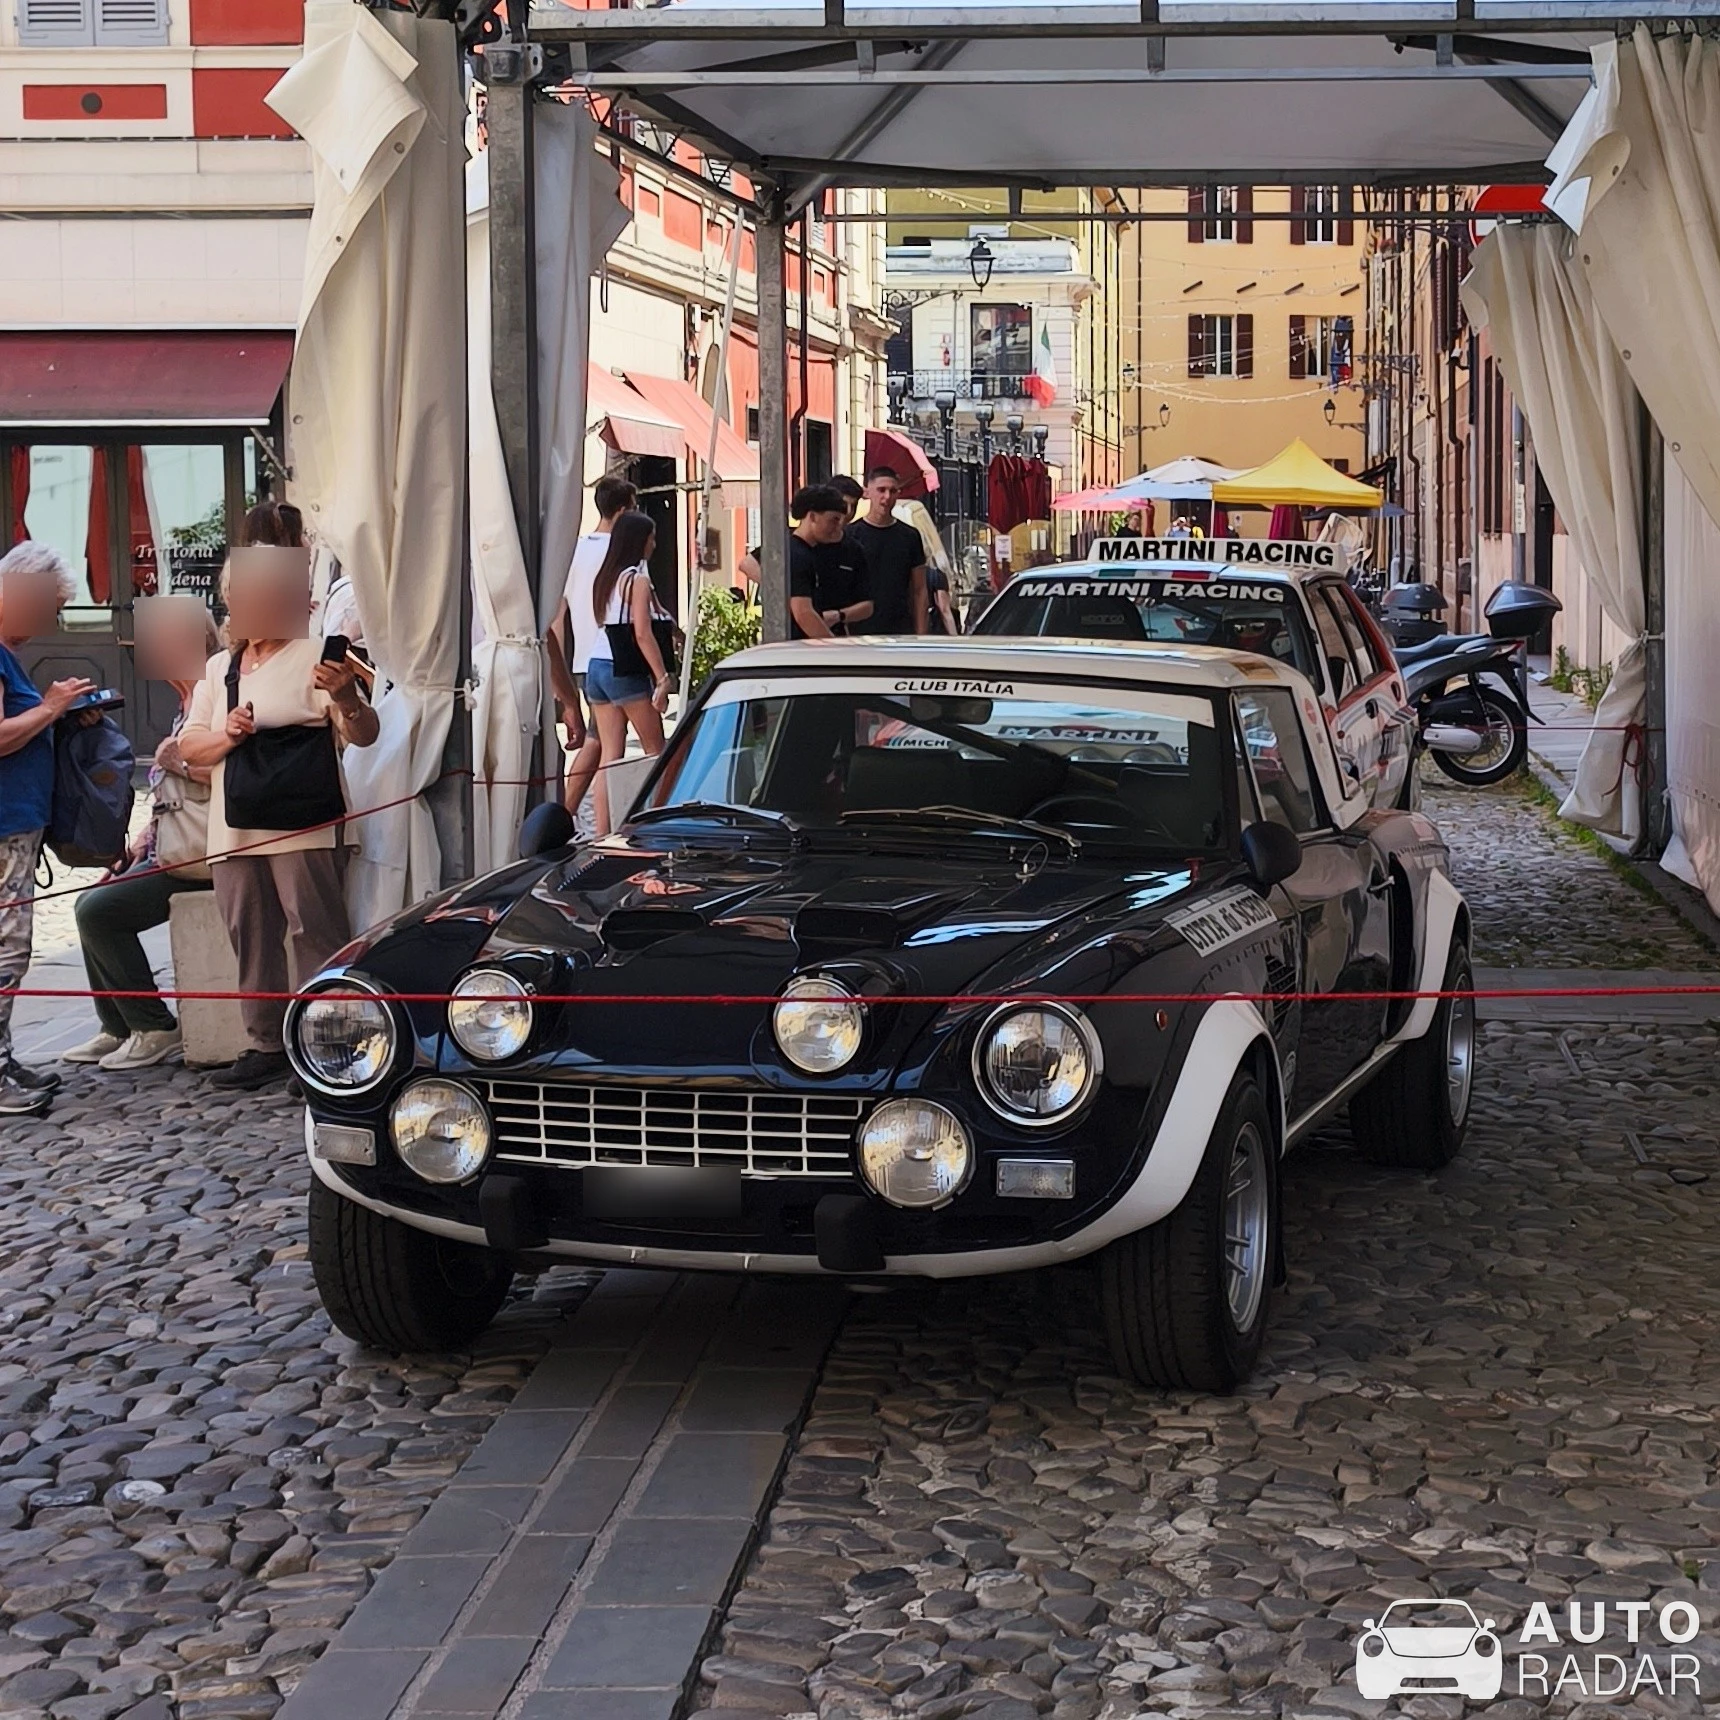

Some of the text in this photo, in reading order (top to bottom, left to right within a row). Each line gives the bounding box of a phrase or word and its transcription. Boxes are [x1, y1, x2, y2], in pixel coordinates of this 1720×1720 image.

[1098, 540, 1335, 566] MARTINI RACING
[171, 559, 183, 569] di
[143, 570, 212, 586] Mdena
[1018, 582, 1285, 602] MARTINI RACING
[893, 680, 1015, 695] CLUB ITALIA
[1002, 727, 1153, 742] MARTINI
